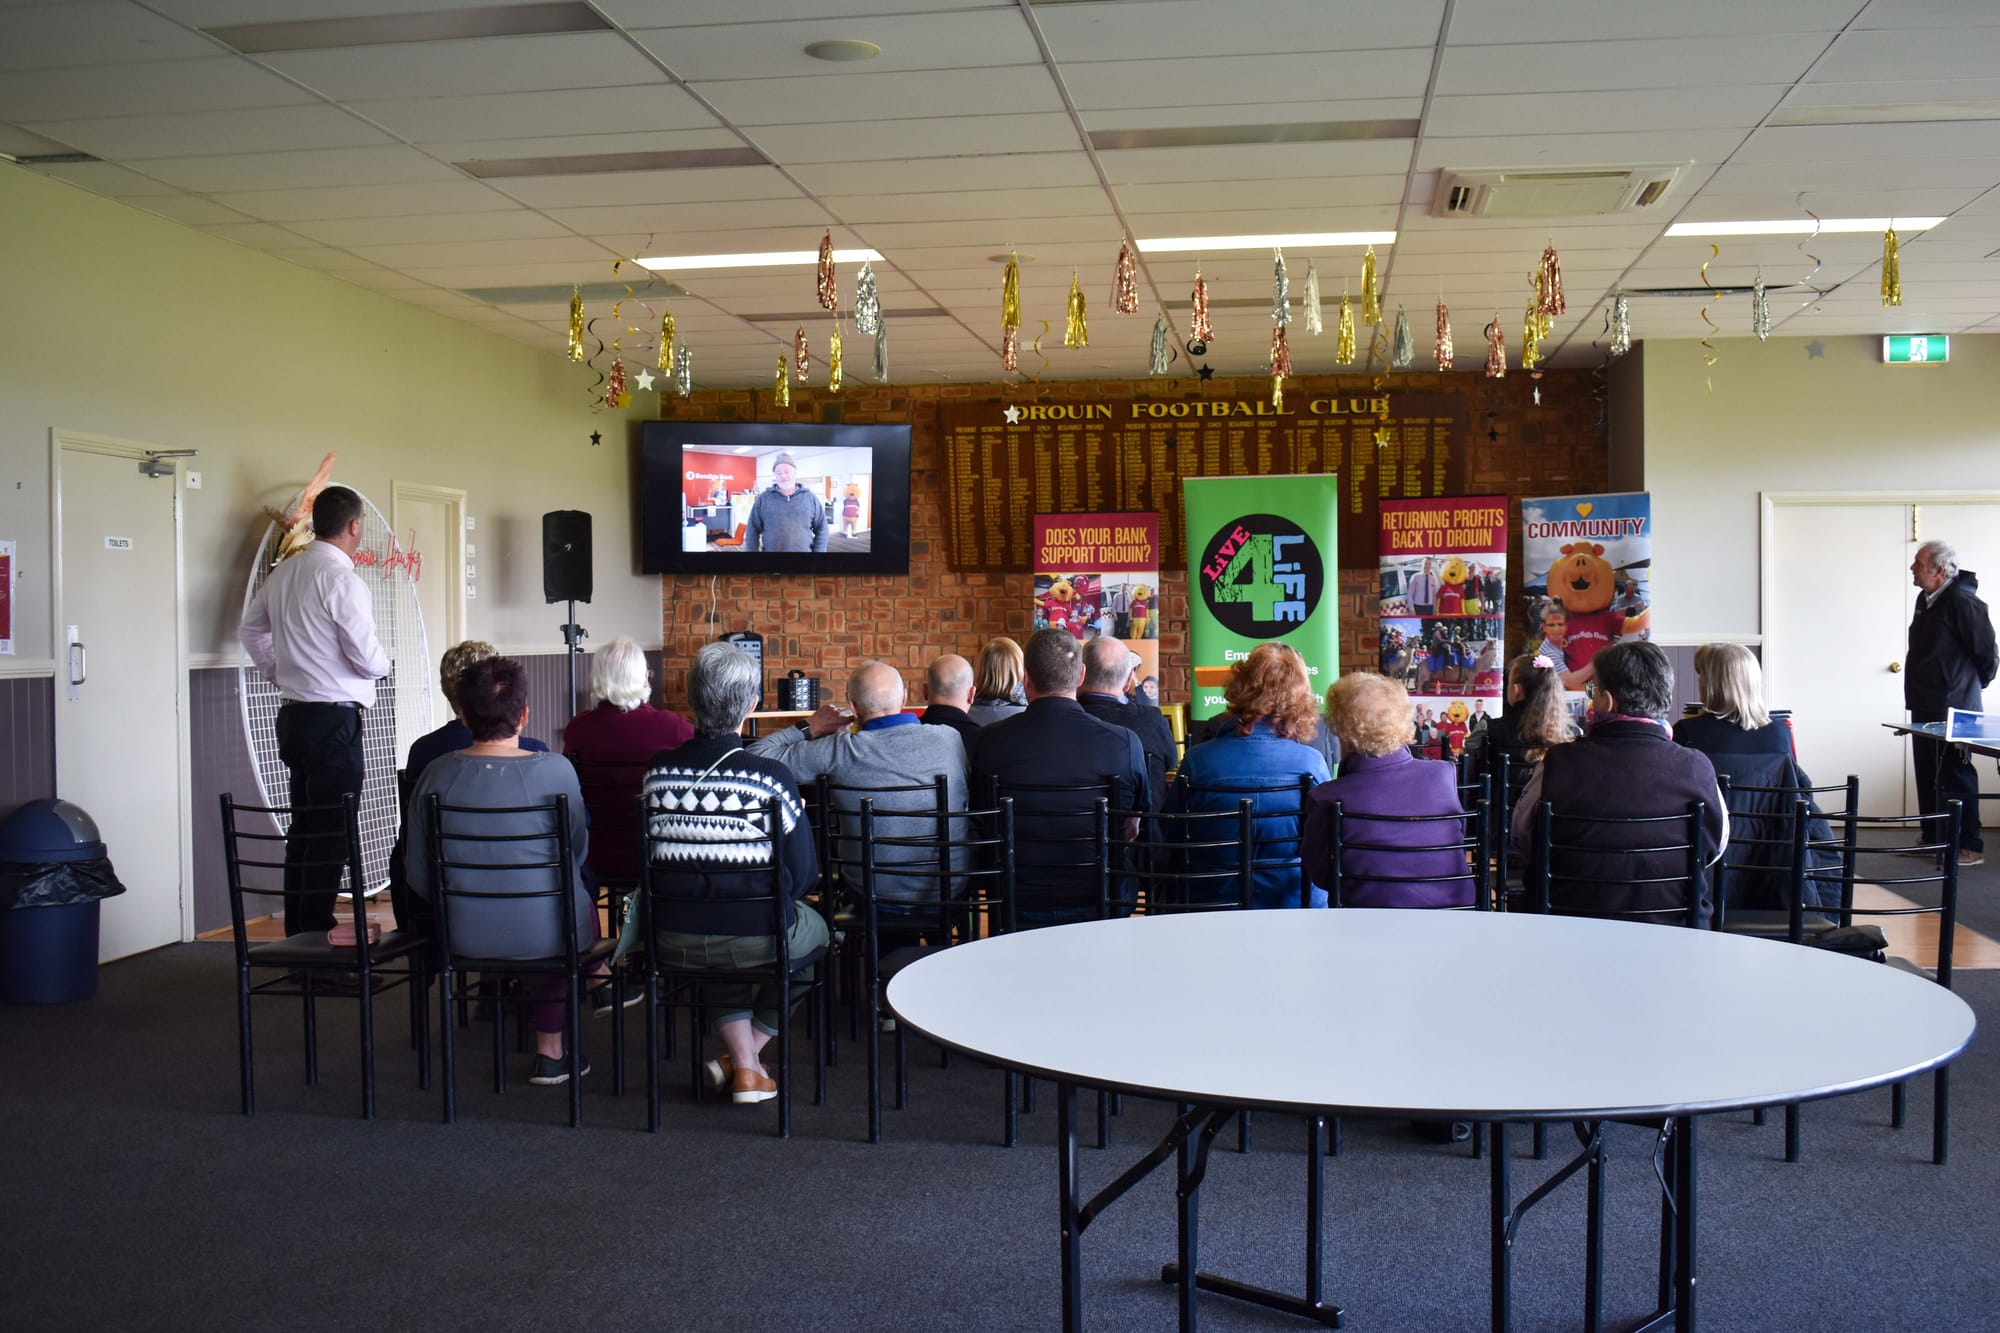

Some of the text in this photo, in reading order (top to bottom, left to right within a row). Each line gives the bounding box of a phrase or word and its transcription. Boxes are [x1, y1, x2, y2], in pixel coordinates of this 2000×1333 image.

[1013, 398, 1390, 420] DROUIN FOOTBALL CLUB
[1383, 508, 1504, 530] RETURNING PROFITS
[1527, 517, 1645, 539] COMMUNITY
[108, 538, 129, 548] TOILETS
[1046, 527, 1148, 546] DOES YOUR BANK
[1392, 528, 1492, 548] BACK TO DROUIN
[1041, 544, 1151, 564] SUPPORT DROUIN?
[1214, 533, 1285, 622] 4
